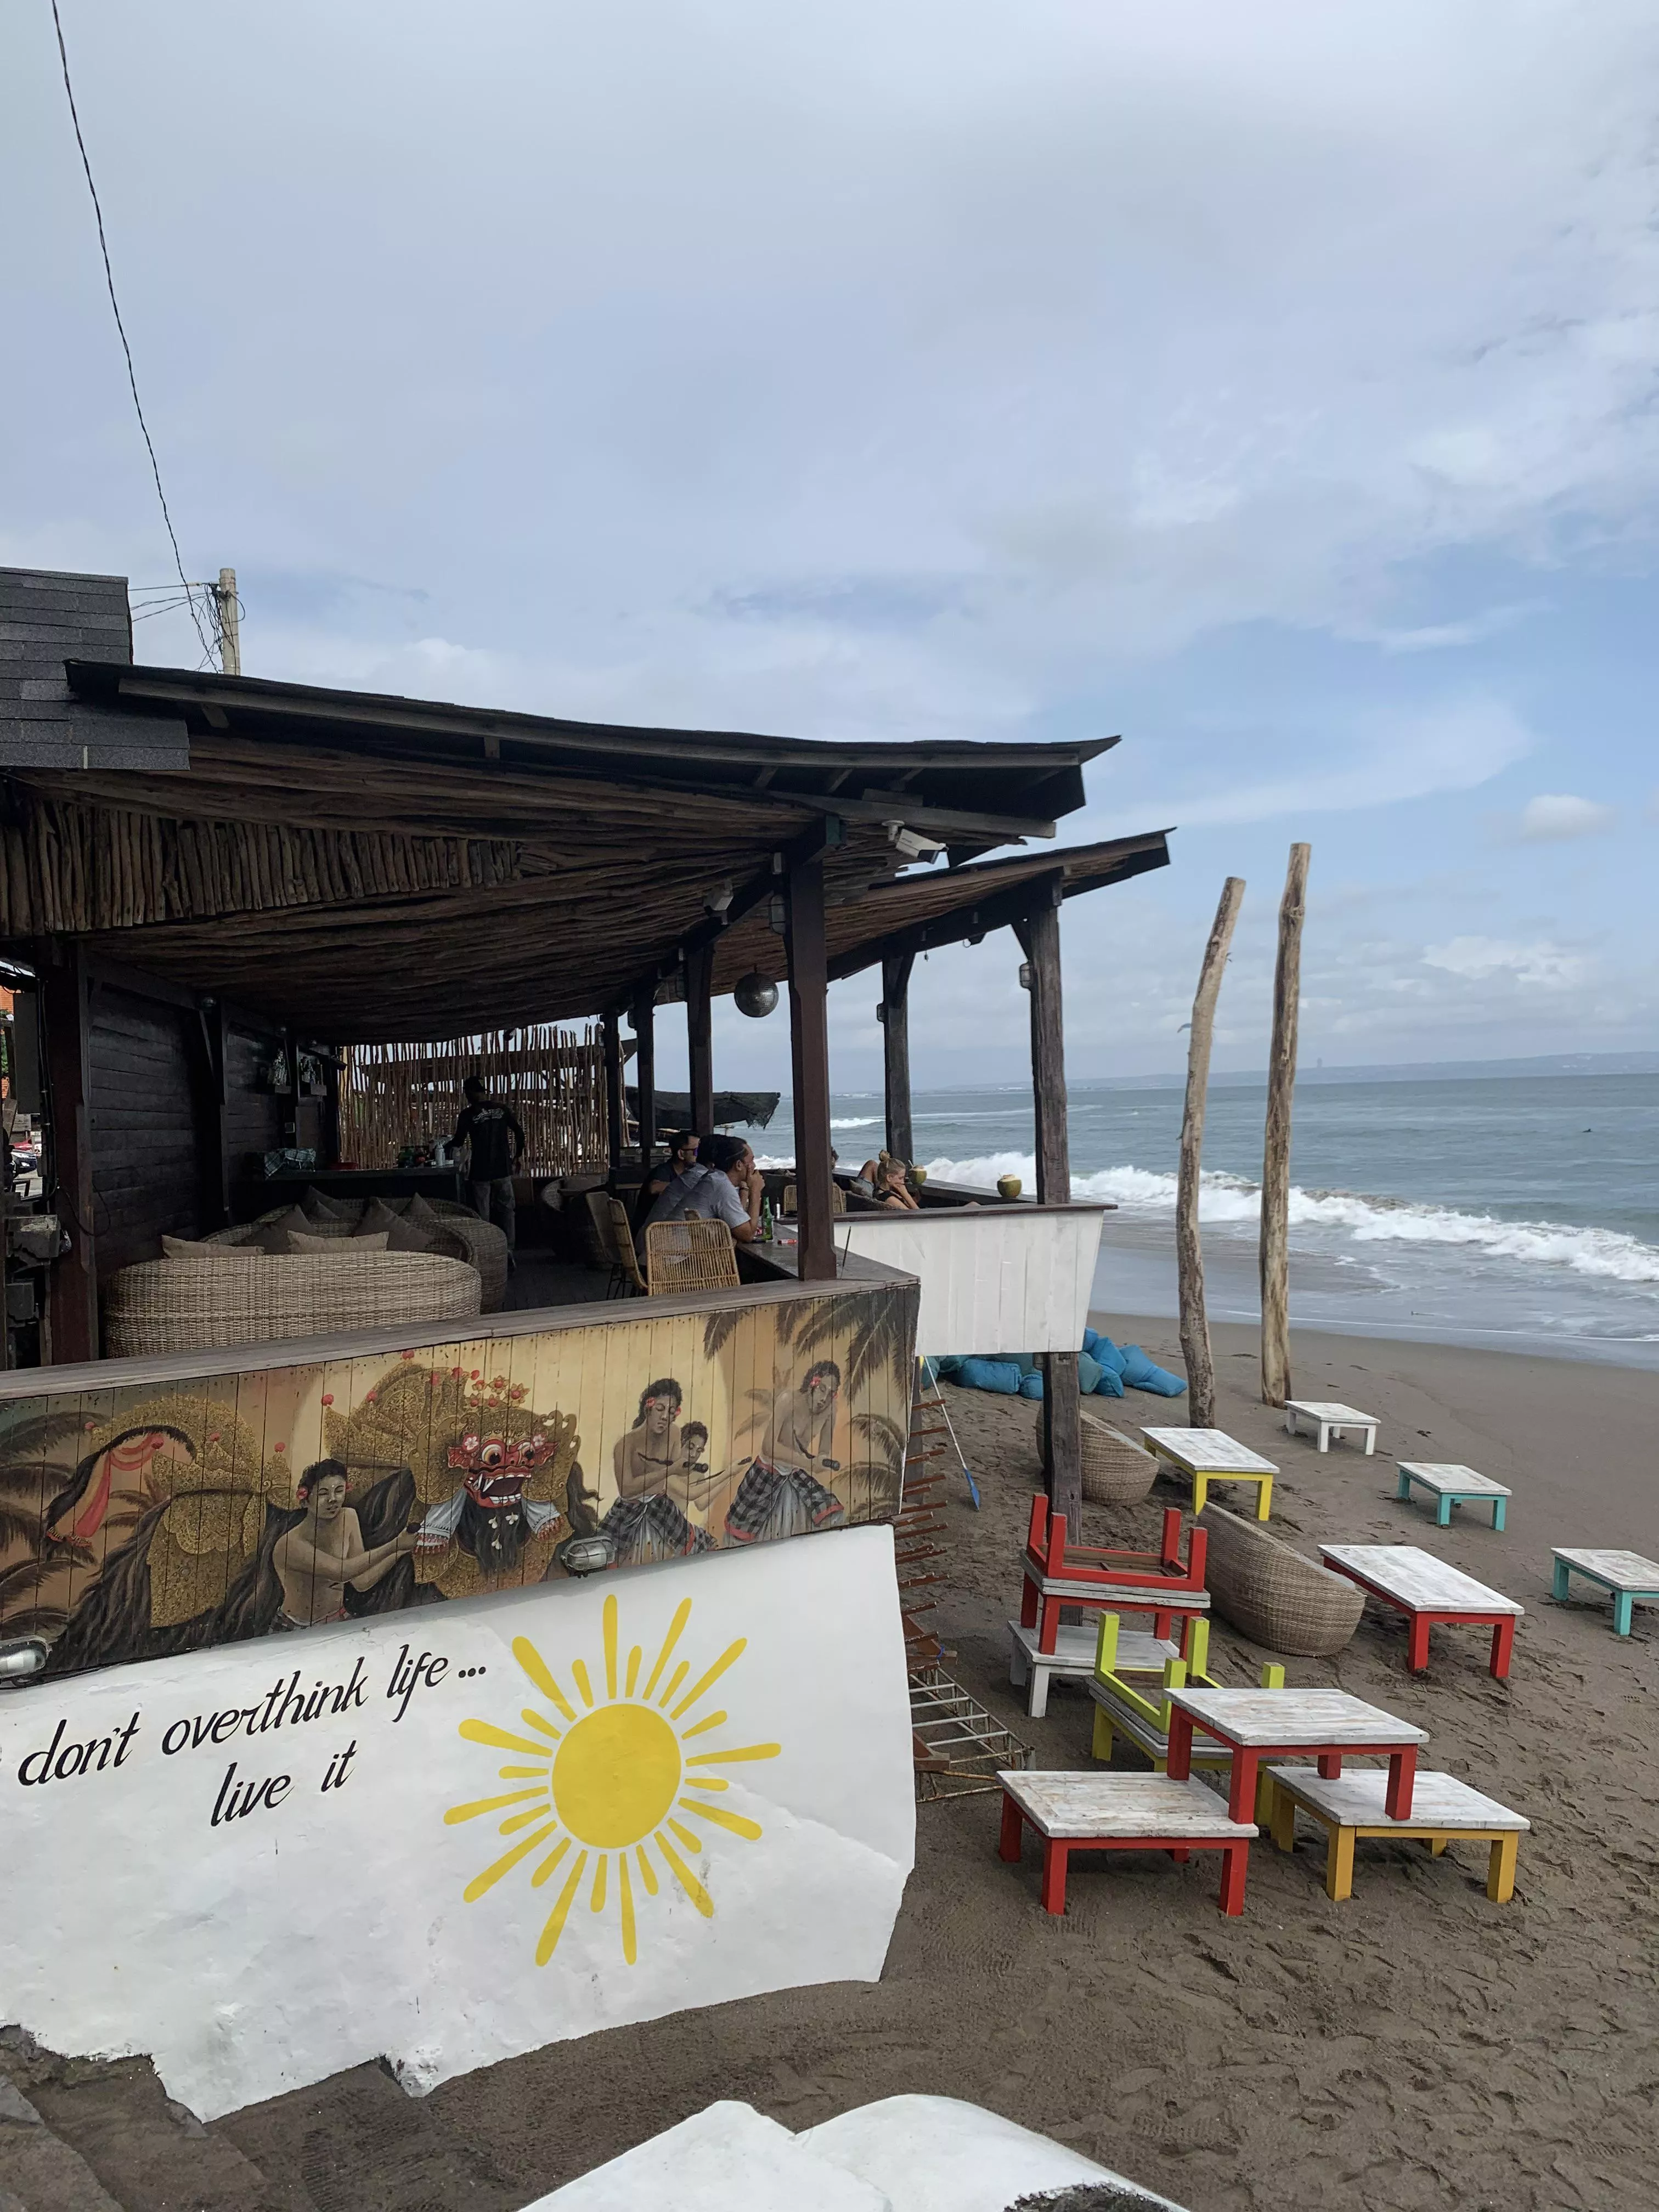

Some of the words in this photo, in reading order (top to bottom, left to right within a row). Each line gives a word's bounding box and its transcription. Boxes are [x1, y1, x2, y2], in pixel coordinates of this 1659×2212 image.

[18, 1711, 141, 1786] don't
[162, 1656, 369, 1755] overthink
[211, 1762, 294, 1827] live
[321, 1740, 358, 1793] it
